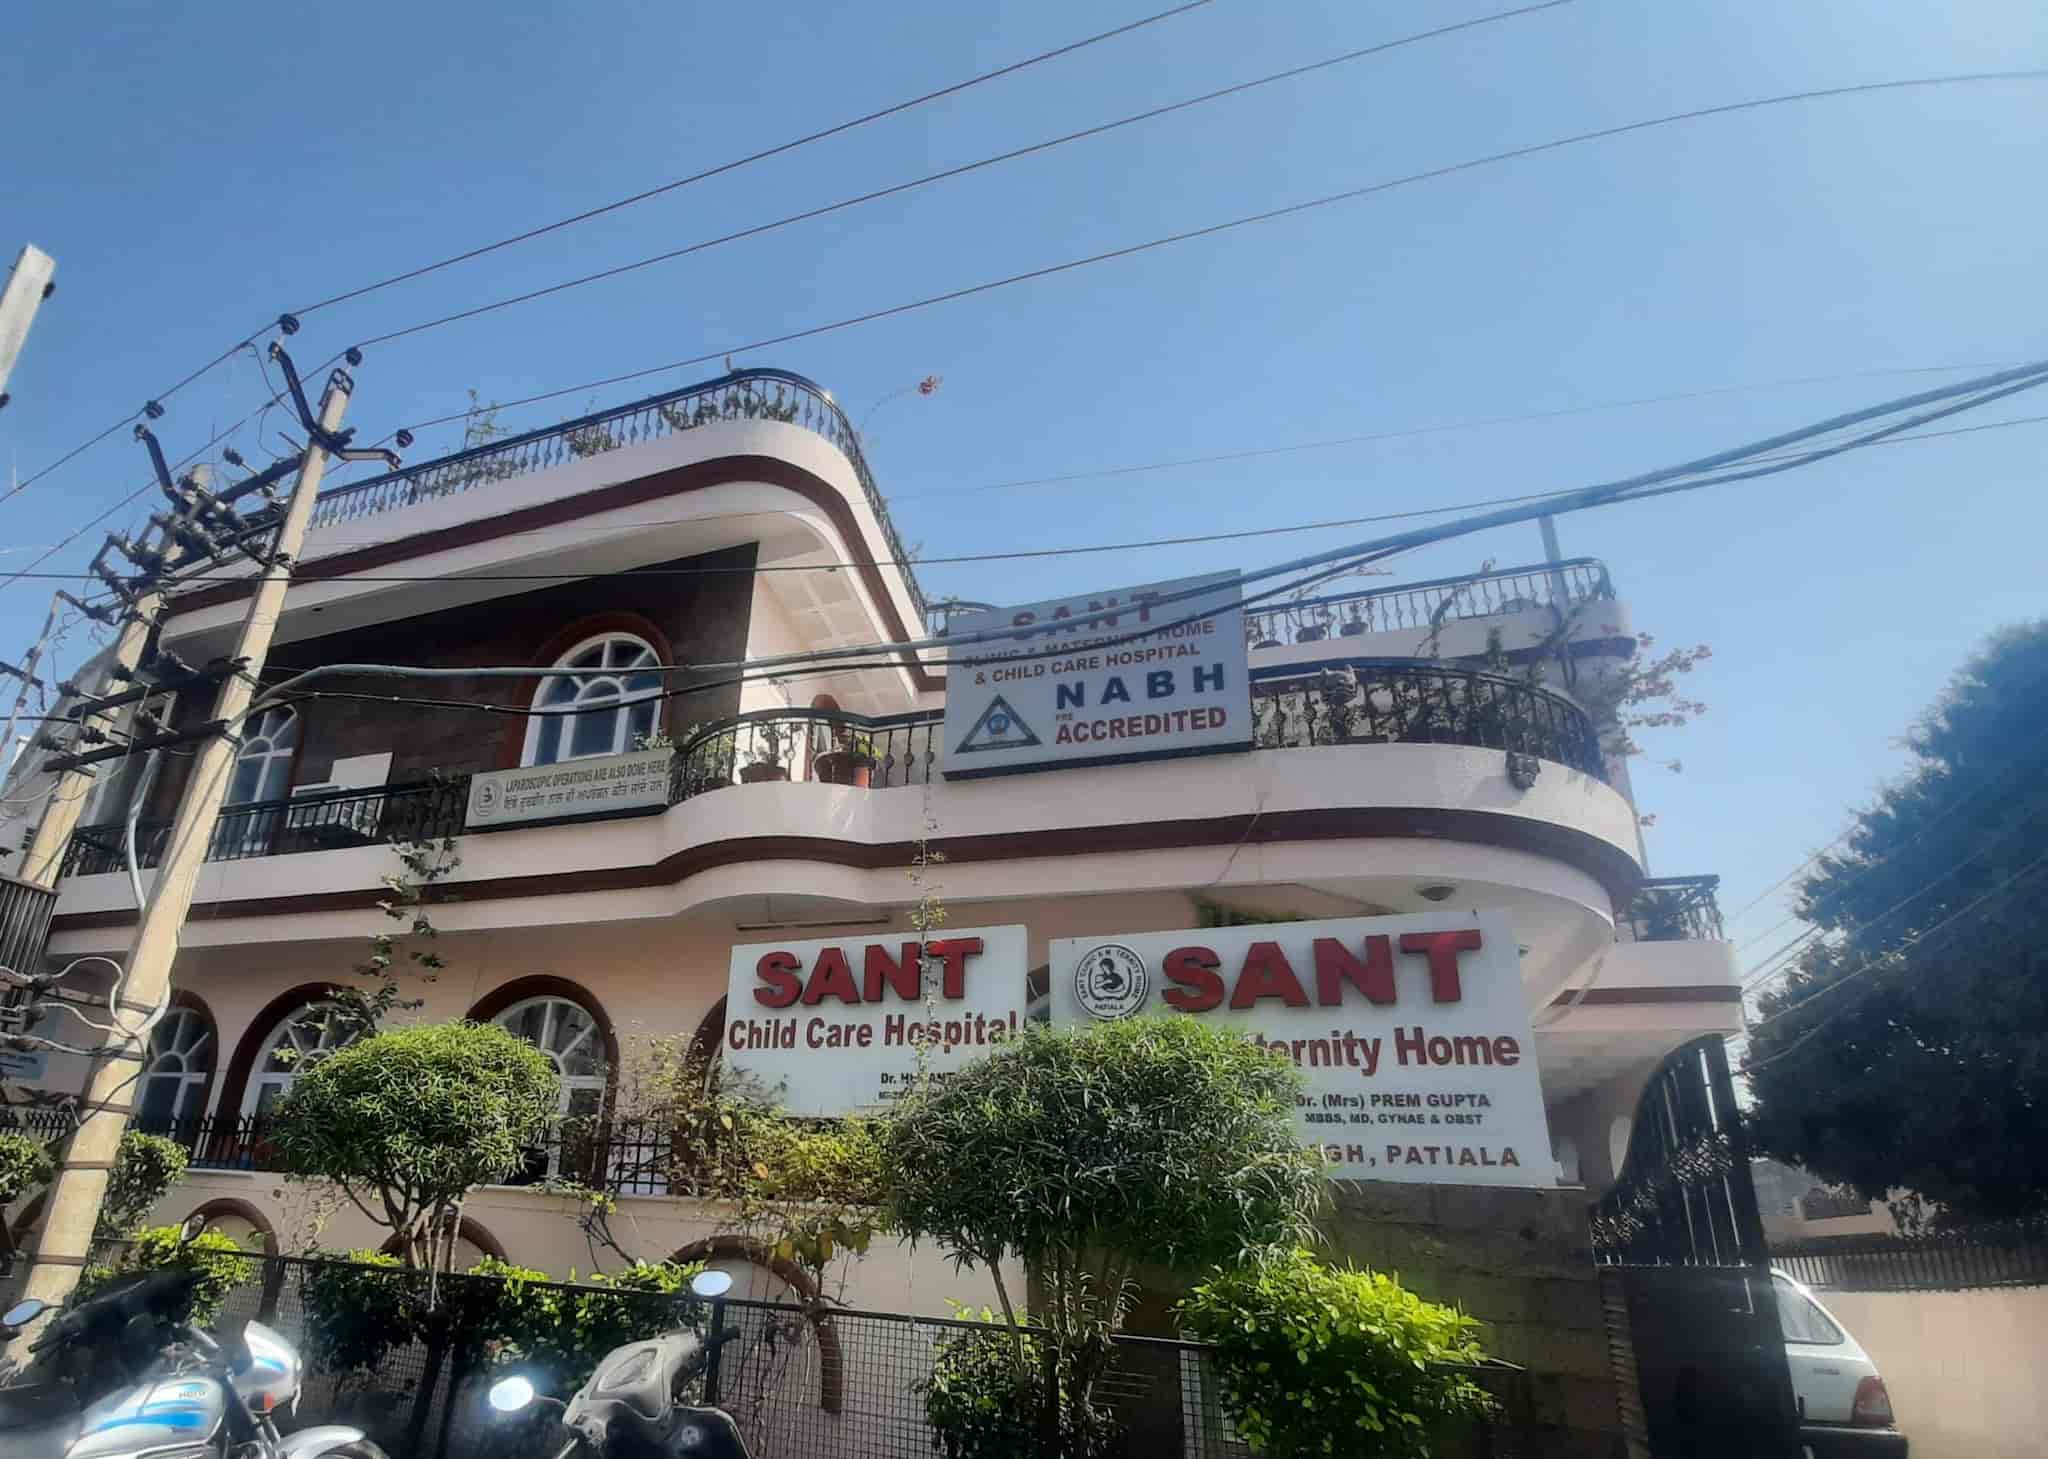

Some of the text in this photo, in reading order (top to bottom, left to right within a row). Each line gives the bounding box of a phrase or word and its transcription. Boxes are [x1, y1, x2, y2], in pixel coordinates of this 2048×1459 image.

[1012, 591, 1160, 641] SANT
[975, 643, 1201, 685] & CHILD CARE HOSPITAL
[1055, 706, 1227, 745] ACCREDITED
[753, 936, 984, 1009] SANT
[1161, 929, 1482, 1013] SANT
[728, 1010, 1017, 1054] Child Care Hospital
[1394, 1026, 1520, 1067] Home
[881, 1072, 897, 1084] Dr.
[1304, 1113, 1346, 1126] MBBS,
[1378, 1113, 1425, 1126] GYNAE
[1431, 1114, 1441, 1126] &
[1444, 1113, 1484, 1126] OBST
[1322, 1093, 1365, 1110] (Mrs)
[1371, 1094, 1421, 1108] PREM
[1427, 1093, 1491, 1108] GUPTA
[1322, 1144, 1521, 1168] GH, PATIALA
